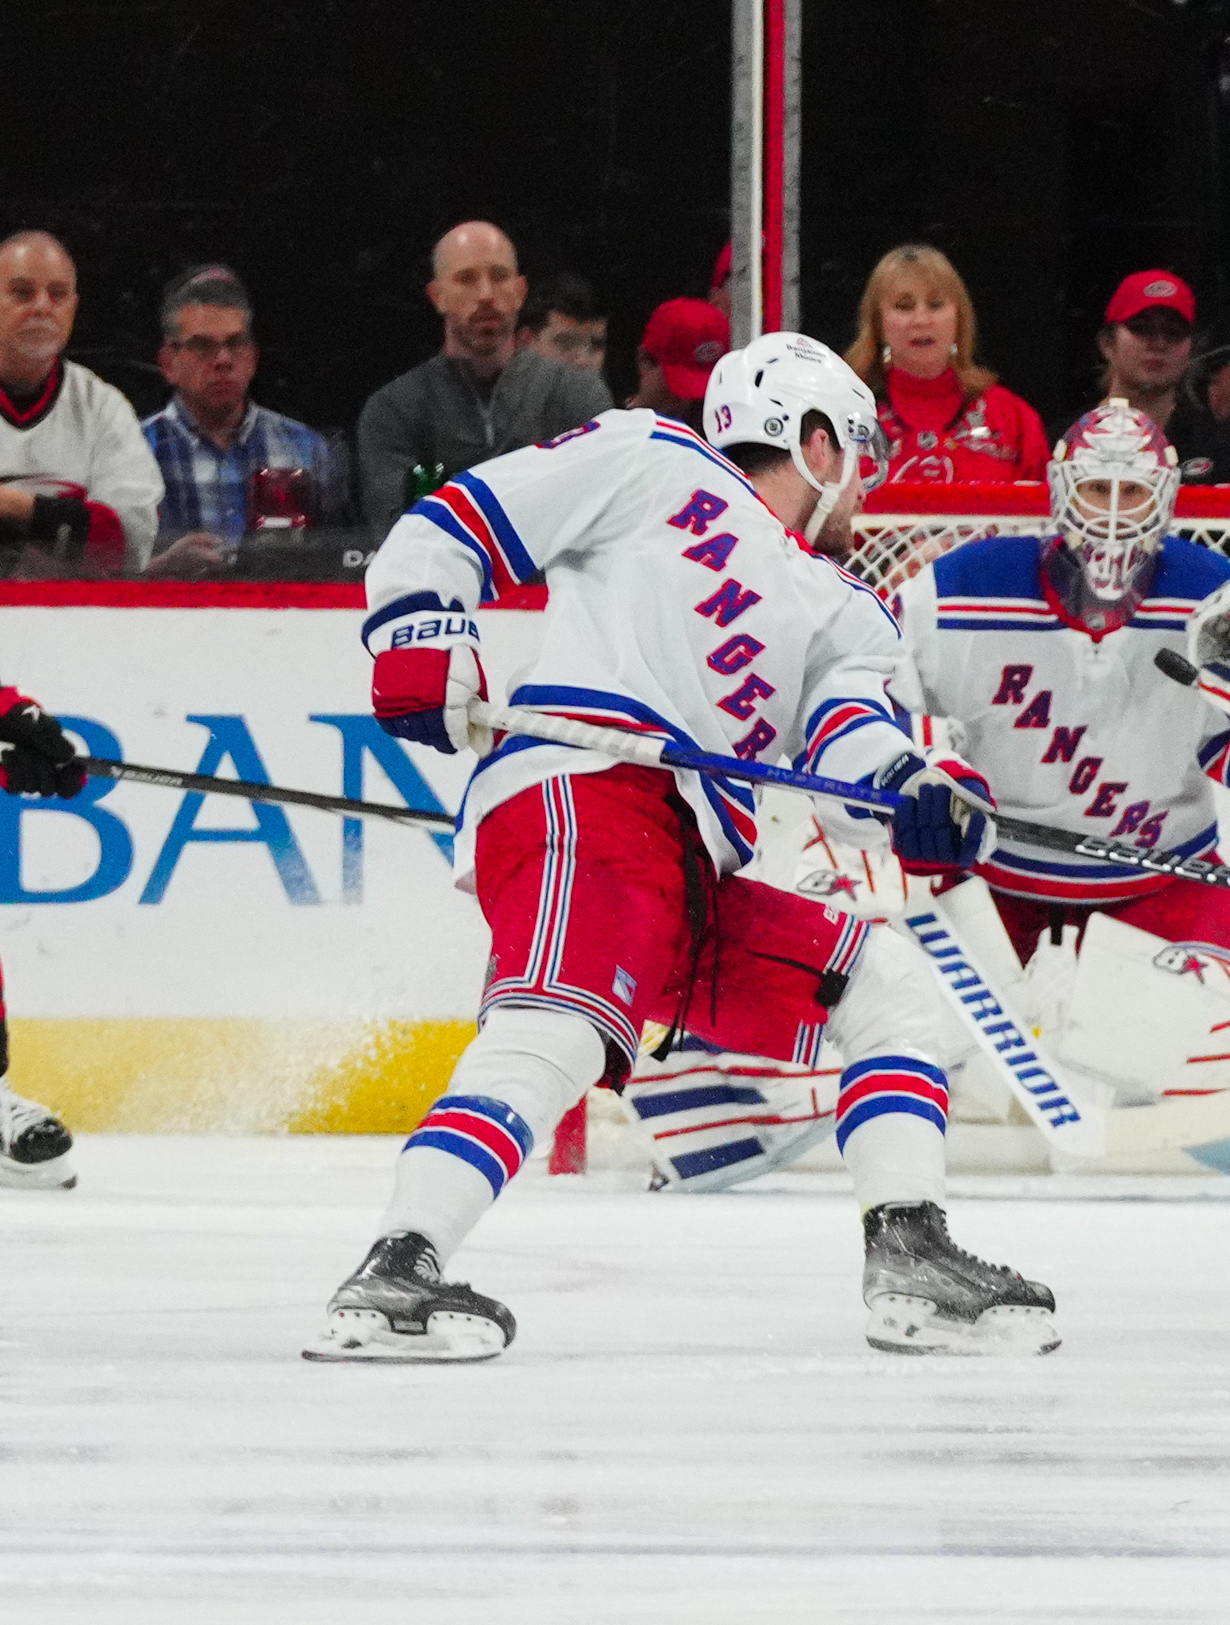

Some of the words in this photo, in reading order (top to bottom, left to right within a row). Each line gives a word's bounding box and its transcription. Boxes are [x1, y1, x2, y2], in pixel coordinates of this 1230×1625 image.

[714, 404, 732, 434] 13
[992, 664, 1169, 848] RANGERS
[905, 911, 1081, 1128] WARRIOR
